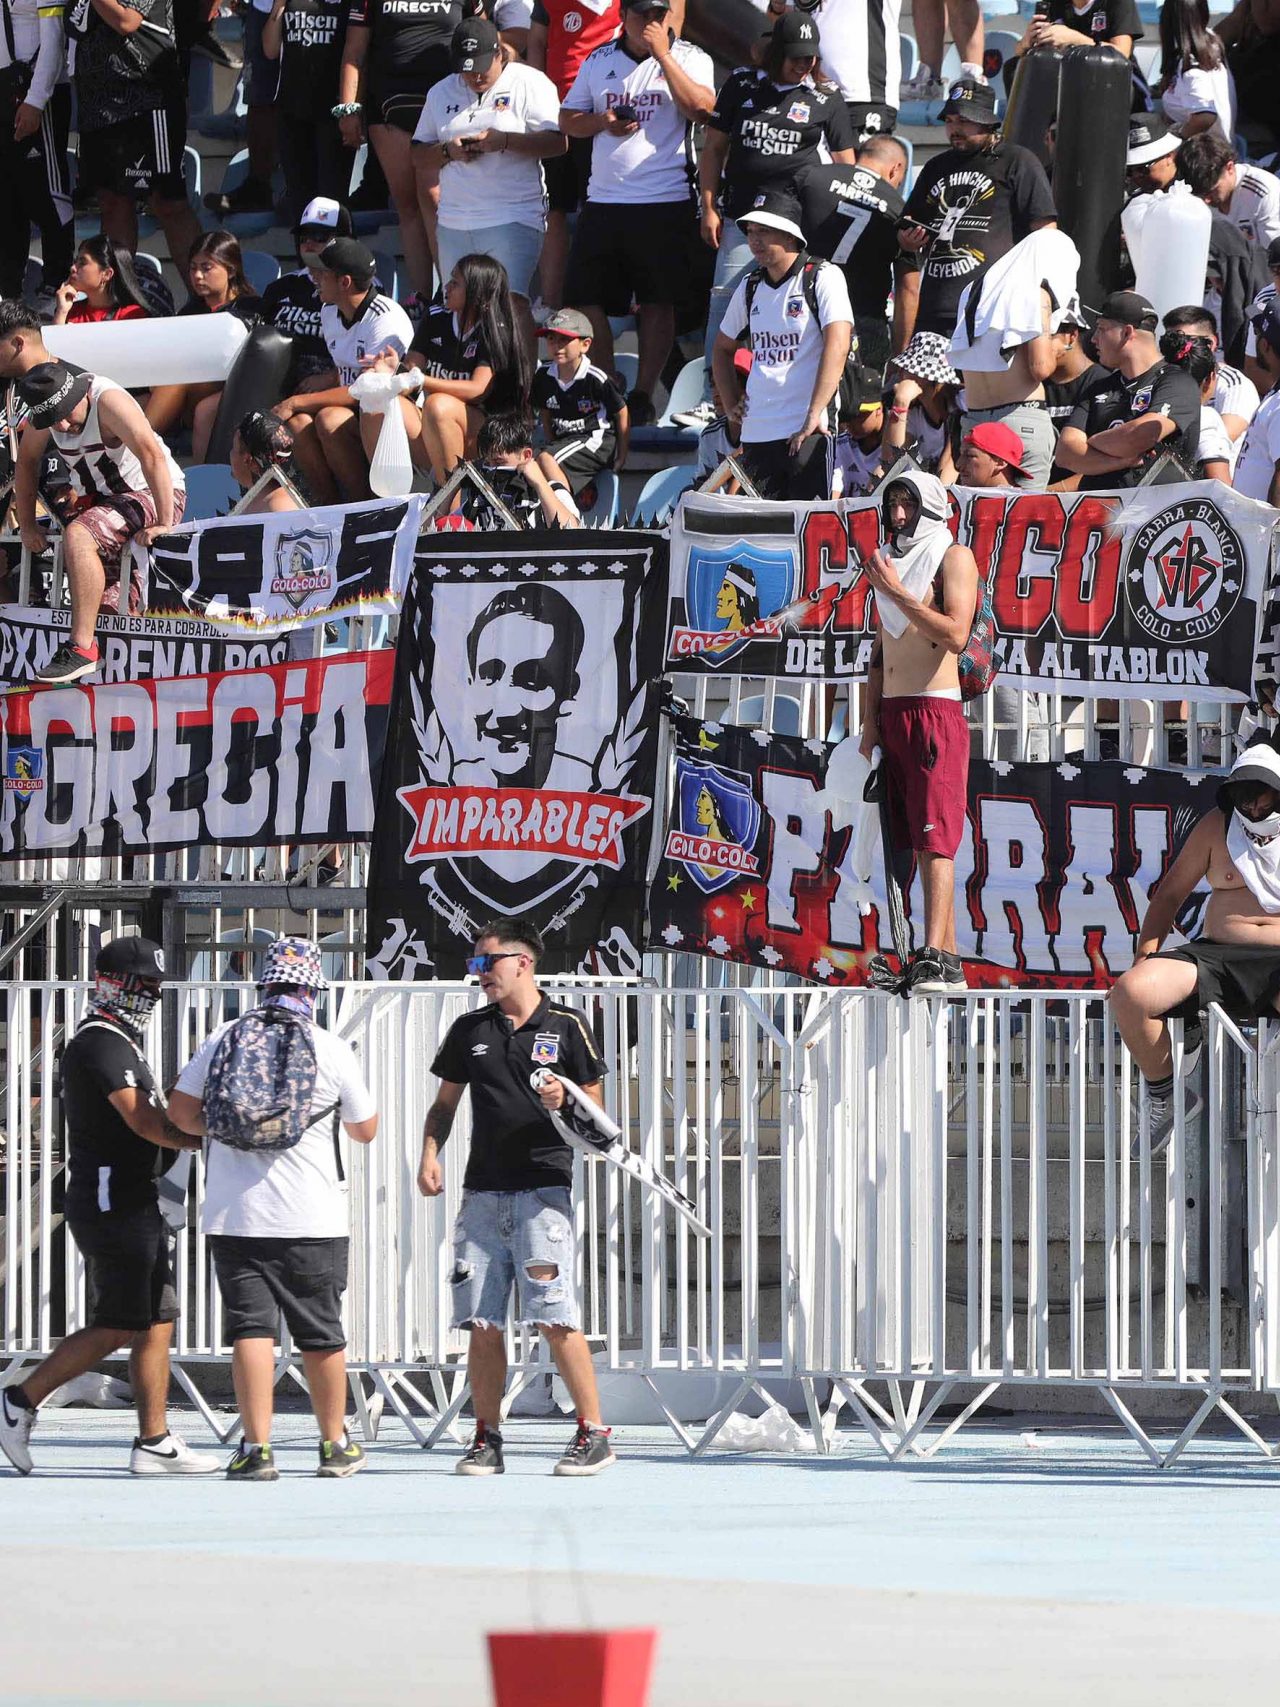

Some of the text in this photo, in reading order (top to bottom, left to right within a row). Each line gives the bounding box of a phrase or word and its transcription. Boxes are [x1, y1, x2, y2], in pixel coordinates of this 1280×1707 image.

[285, 11, 338, 31] Pilsen
[287, 30, 335, 46] del Sur
[741, 120, 801, 142] Pilsen
[743, 138, 799, 155] del Sur
[125, 167, 152, 177] Rexona
[949, 171, 993, 192] HINCHA
[829, 179, 888, 213] PAREDES
[830, 200, 872, 265] 7
[928, 255, 981, 278] LEYENDA
[274, 306, 321, 322] Pilse
[751, 331, 799, 349] Pilsen
[1138, 504, 1239, 569] GARRA BLANCA
[51, 610, 70, 625] EST
[113, 619, 127, 631] NO
[130, 620, 142, 633] ES
[145, 621, 172, 635] PARA
[785, 639, 826, 674] DE
[1037, 642, 1082, 680] AL
[1089, 645, 1210, 685] TABLON
[418, 796, 625, 854] IMPARABLES
